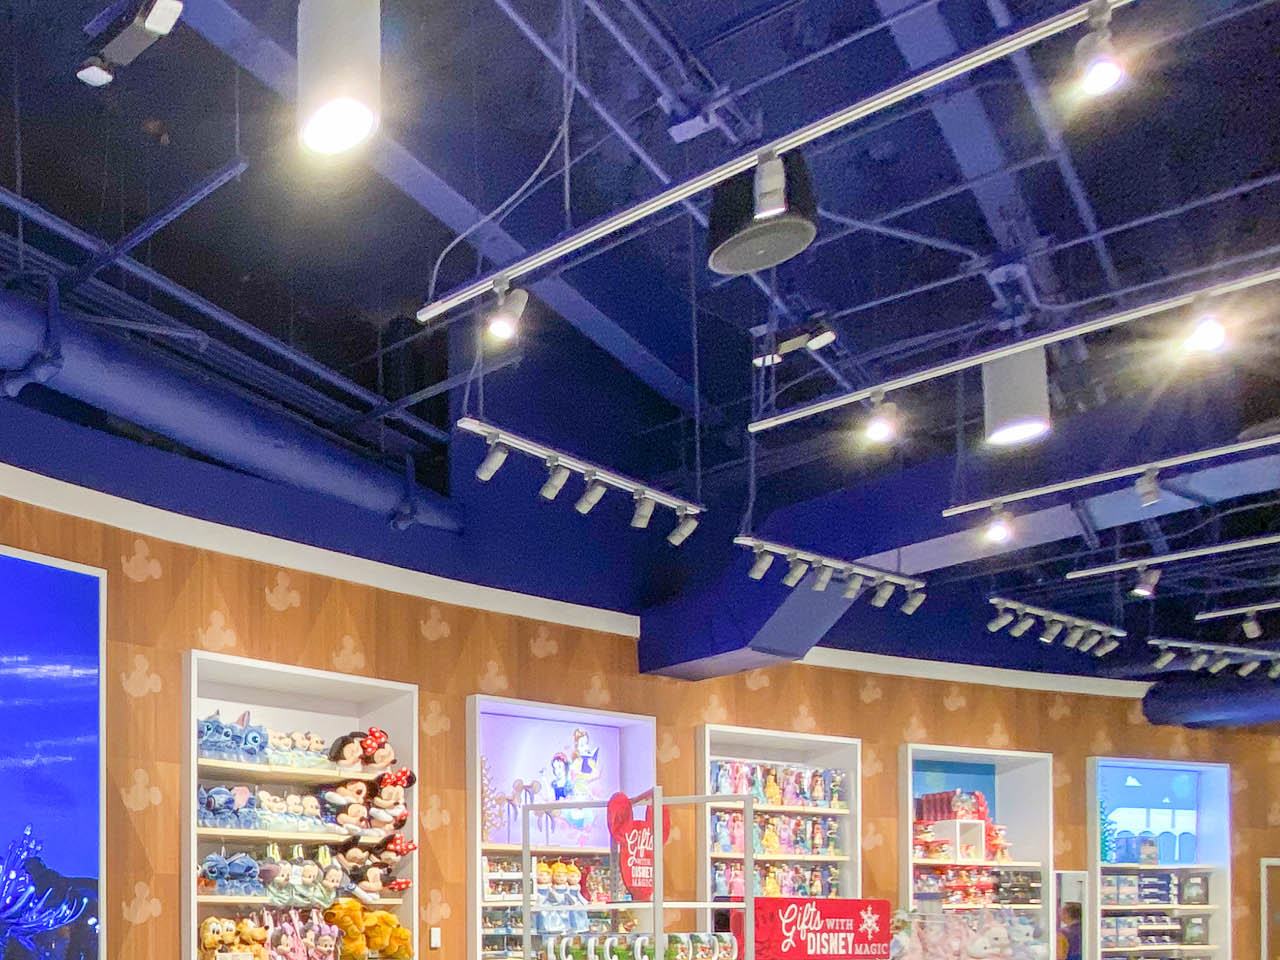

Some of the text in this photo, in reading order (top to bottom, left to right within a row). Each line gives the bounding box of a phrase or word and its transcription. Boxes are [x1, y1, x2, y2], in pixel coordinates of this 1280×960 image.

[778, 901, 854, 953] Gifts WITH
[807, 932, 889, 955] DISNEY MAGIC
